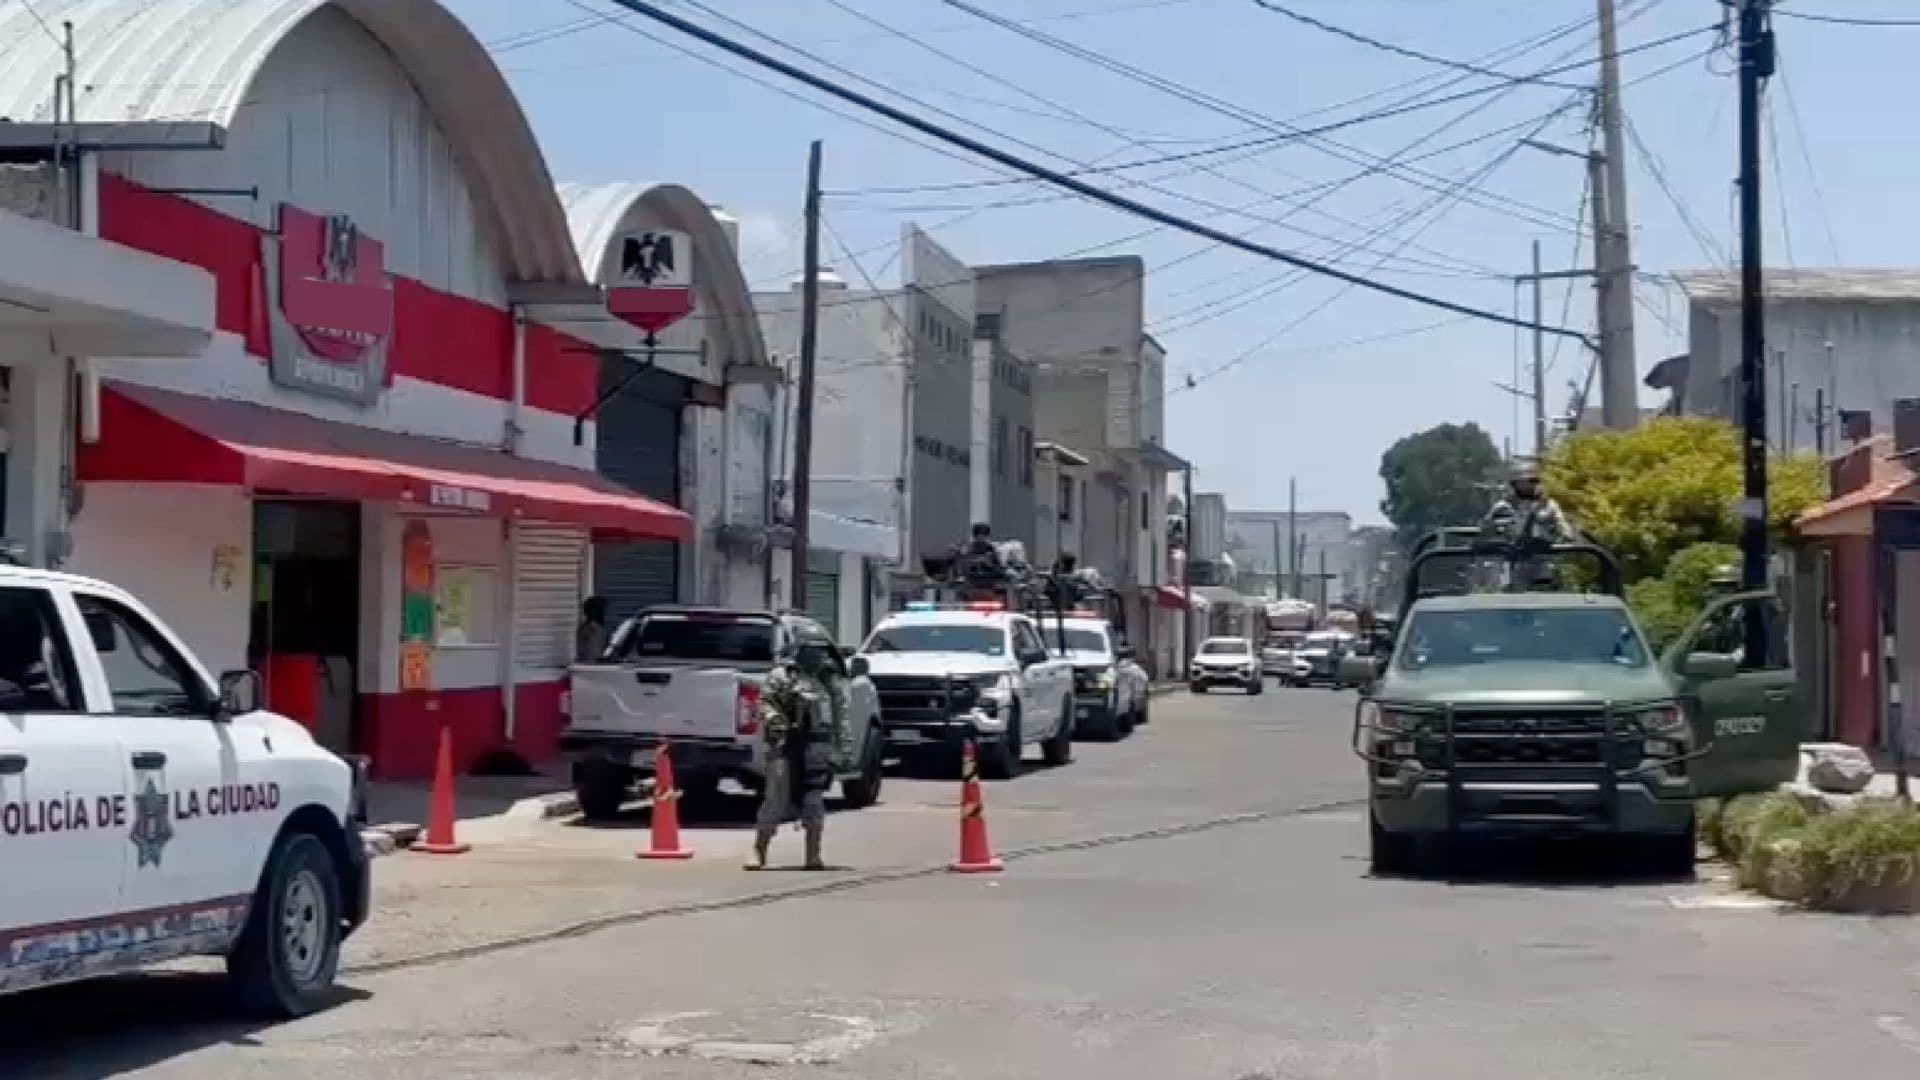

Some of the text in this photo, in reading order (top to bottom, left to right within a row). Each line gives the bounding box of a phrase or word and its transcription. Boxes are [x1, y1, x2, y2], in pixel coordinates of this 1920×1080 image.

[0, 782, 280, 834] OLICÍA DE LA CIUDAD
